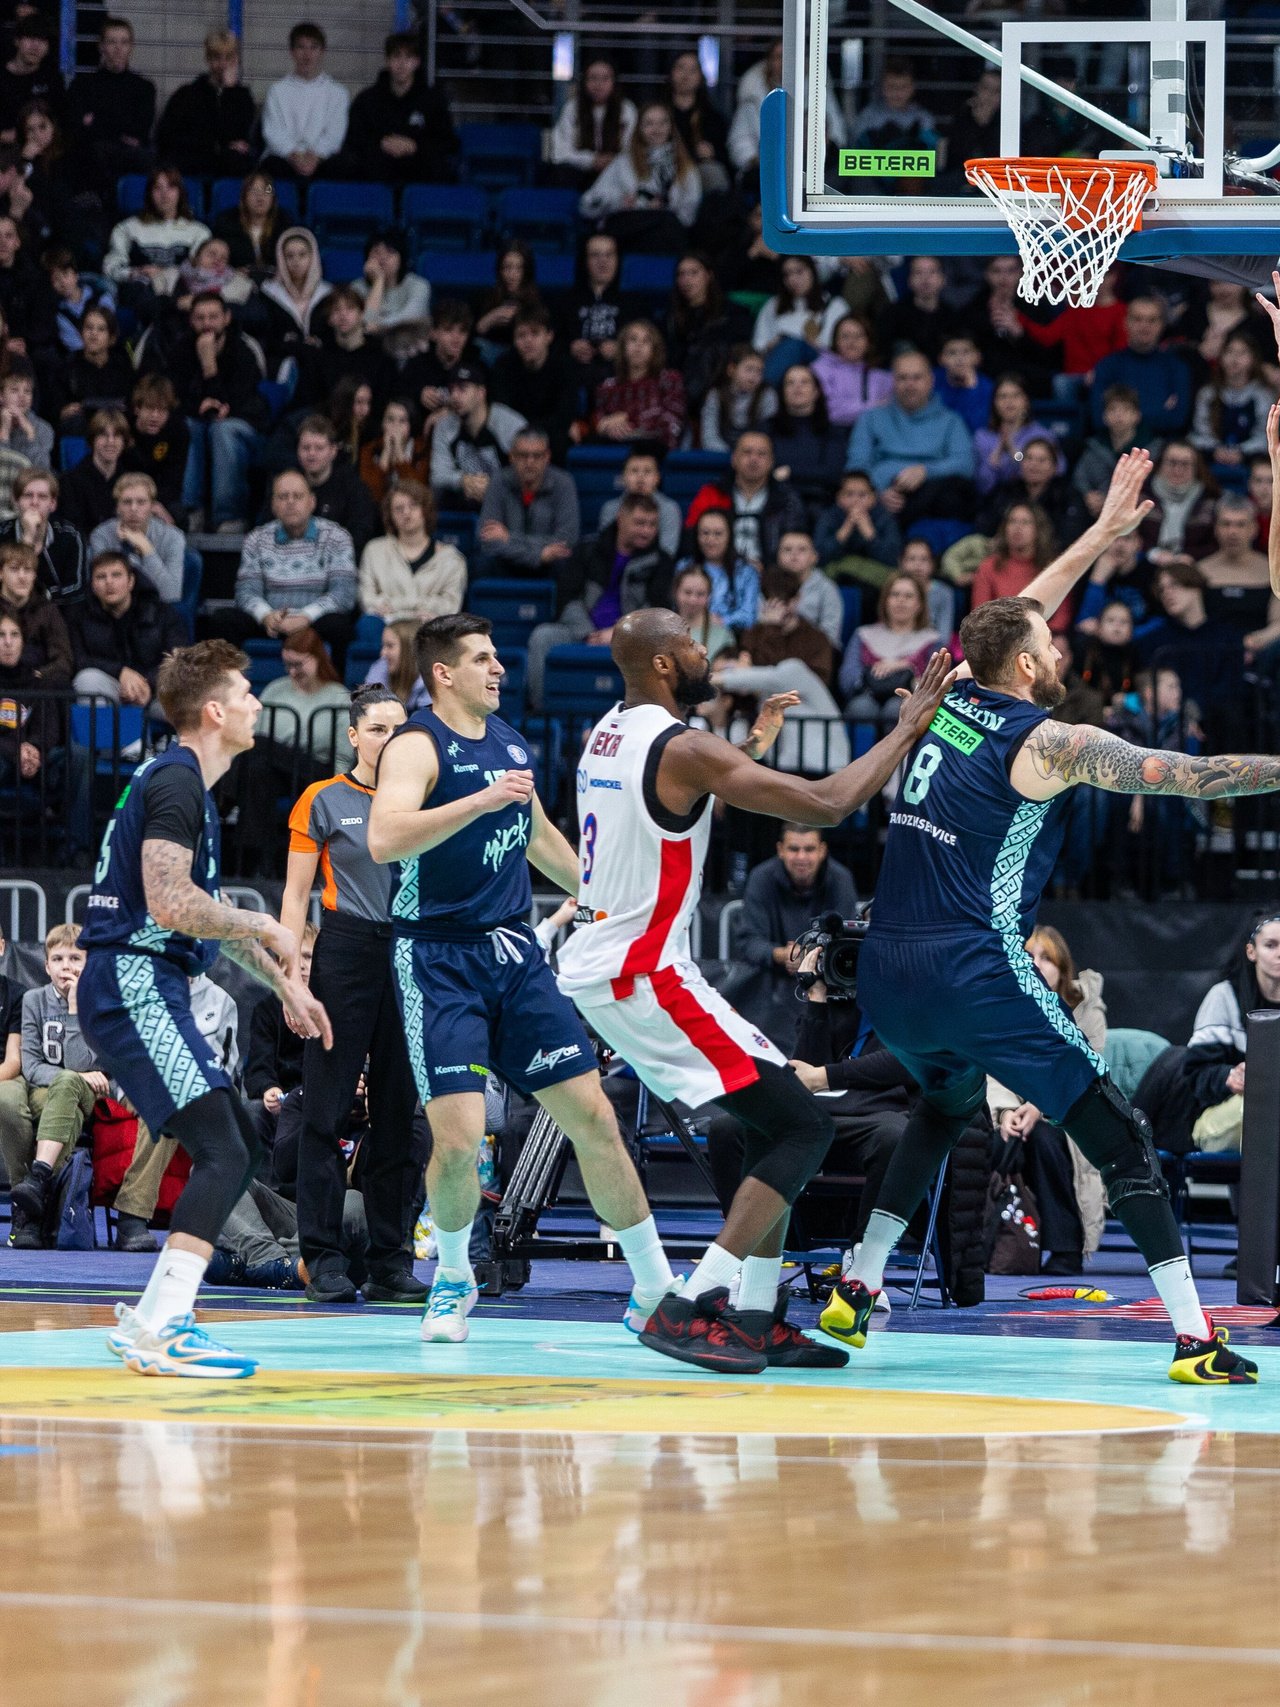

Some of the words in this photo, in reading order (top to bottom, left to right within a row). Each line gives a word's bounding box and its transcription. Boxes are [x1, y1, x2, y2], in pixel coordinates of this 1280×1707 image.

[453, 764, 479, 773] Kempa
[903, 743, 943, 806] 8
[582, 812, 597, 885] 3
[42, 1020, 63, 1065] 6
[435, 1064, 467, 1075] Kempa
